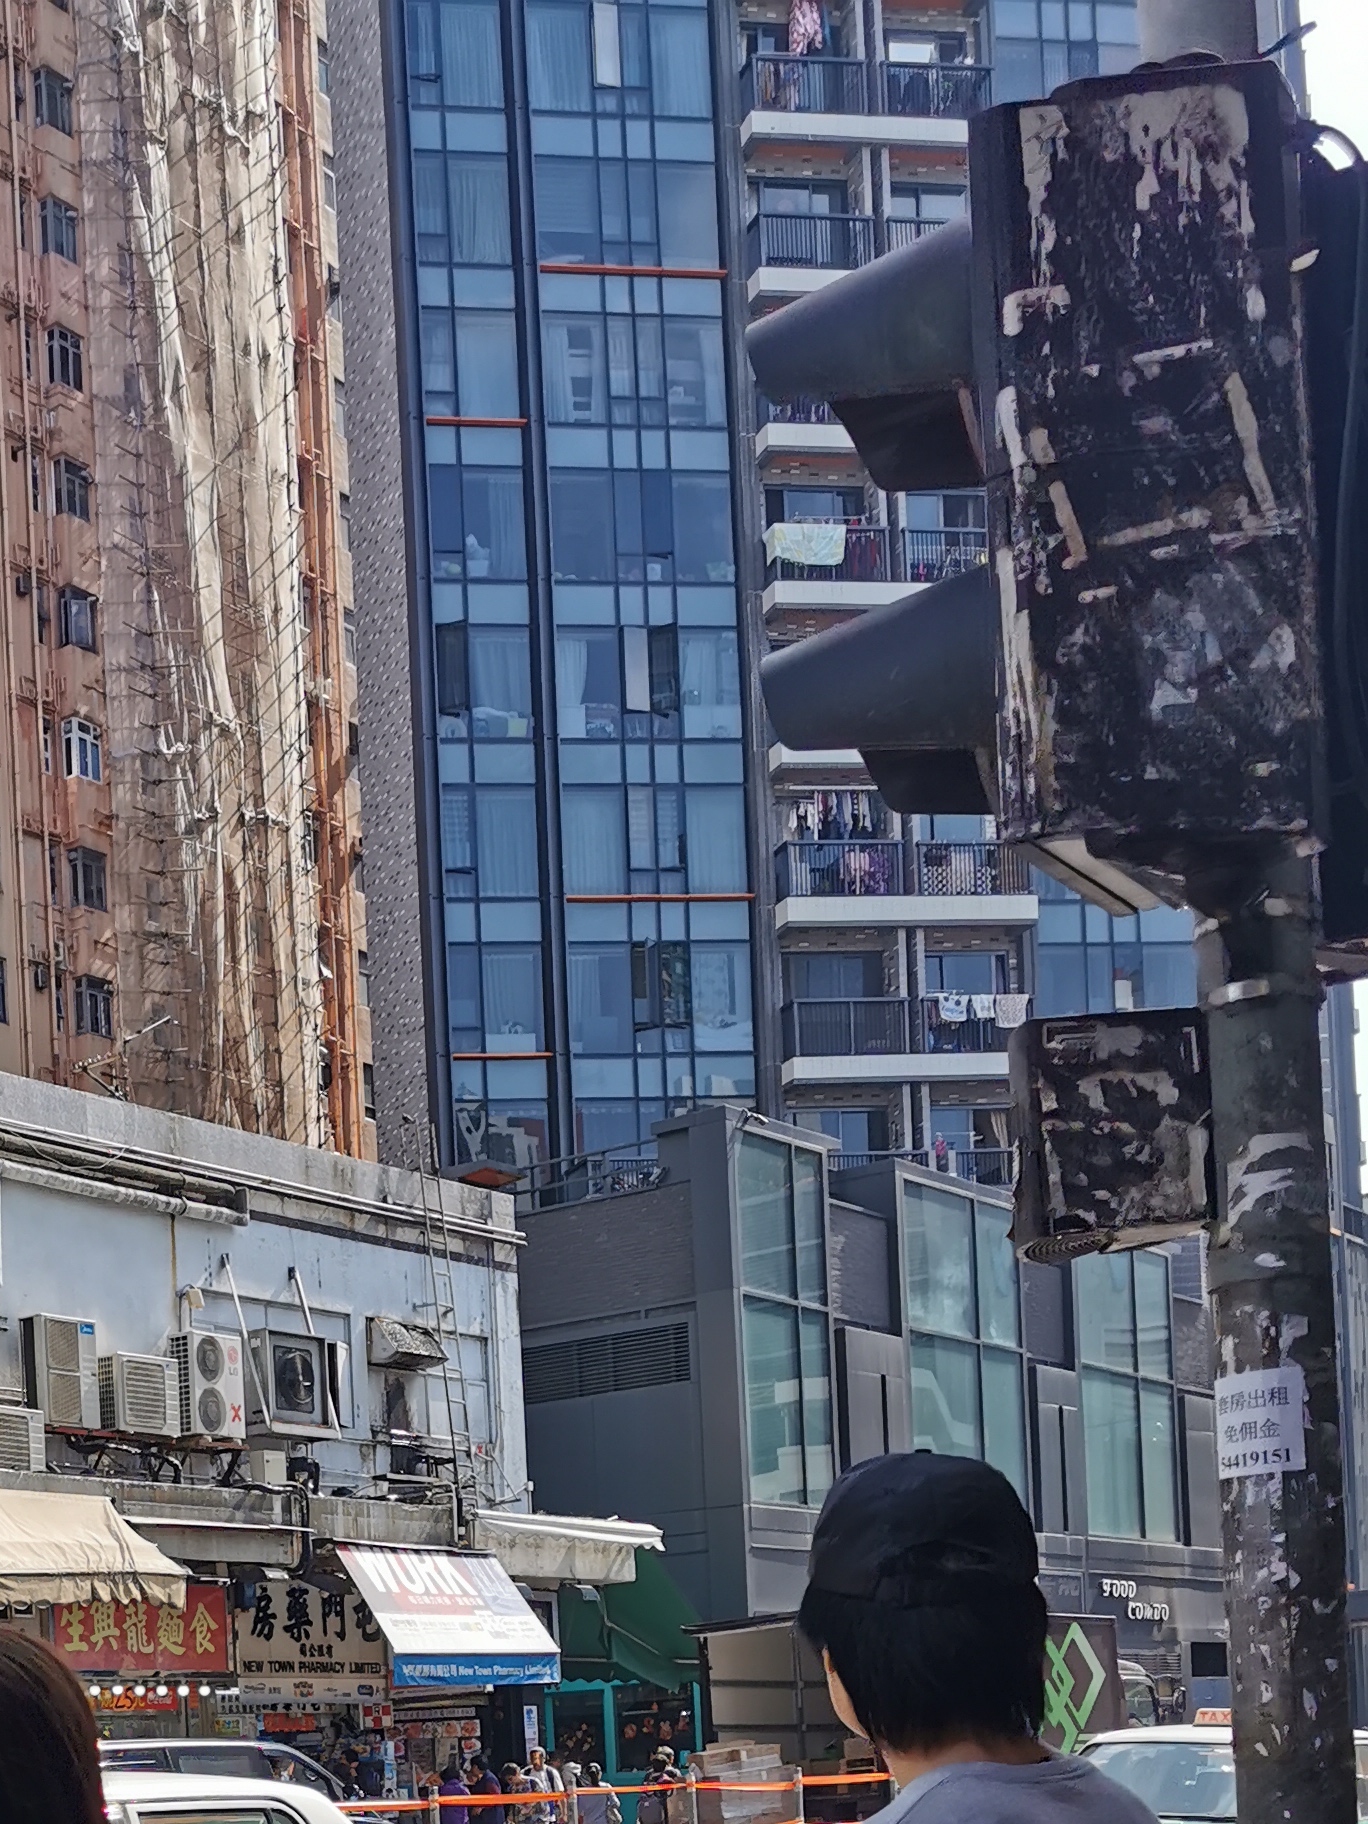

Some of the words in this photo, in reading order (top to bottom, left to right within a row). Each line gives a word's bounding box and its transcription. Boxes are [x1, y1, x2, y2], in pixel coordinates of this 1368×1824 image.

[1218, 1386, 1290, 1416] 套房出租
[1224, 1417, 1281, 1444] 免佣金
[1128, 1602, 1170, 1621] COMBO
[243, 1660, 264, 1674] NEW
[269, 1660, 296, 1674] TOWN
[298, 1660, 345, 1675] PHARMACY
[349, 1661, 382, 1675] LIMITED
[458, 1665, 474, 1676] New
[474, 1665, 493, 1676] Town
[494, 1664, 524, 1677] Pharmacy
[524, 1664, 551, 1676] Limited
[1199, 1711, 1231, 1722] TAX
